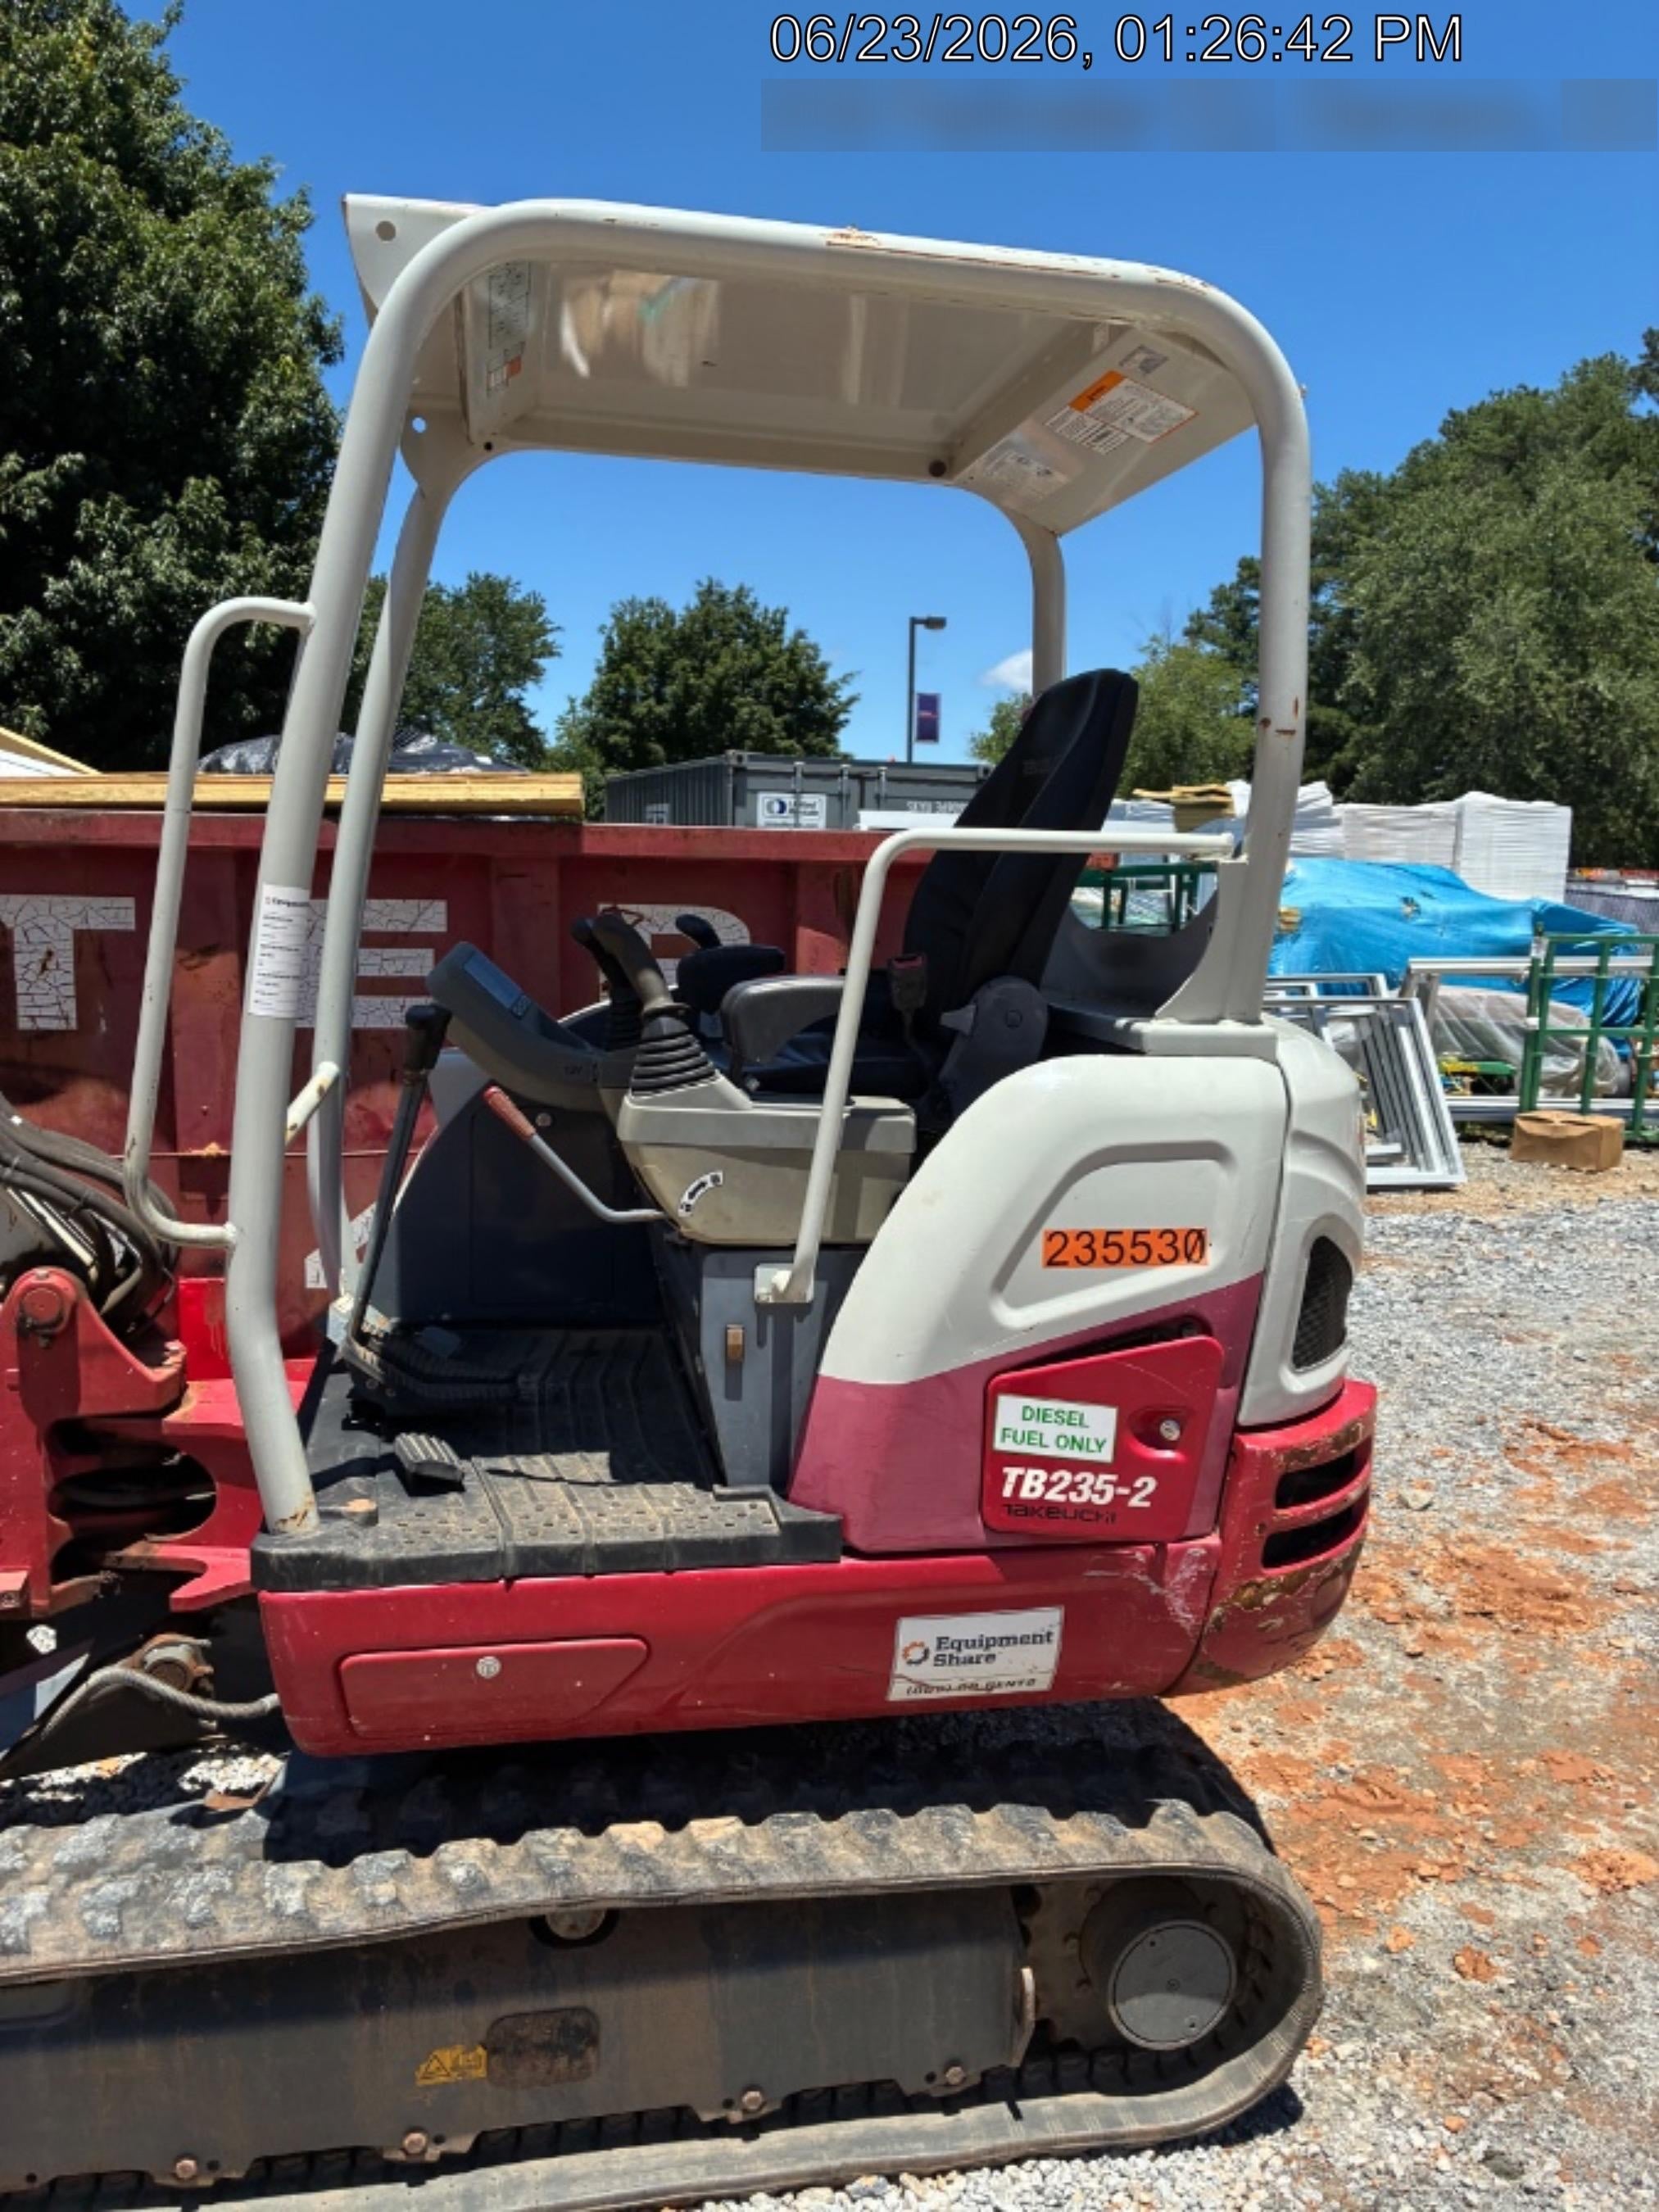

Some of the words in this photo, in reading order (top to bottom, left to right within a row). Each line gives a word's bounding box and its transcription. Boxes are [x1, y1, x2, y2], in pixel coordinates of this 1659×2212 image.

[1045, 1229, 1206, 1267] 235530
[1021, 1404, 1090, 1429] DIESEL
[999, 1430, 1049, 1449] FUEL
[1055, 1434, 1108, 1453] ONLY
[1001, 1466, 1158, 1508] TB235-2
[936, 1630, 1054, 1652] Equipment
[933, 1652, 996, 1667] Share
